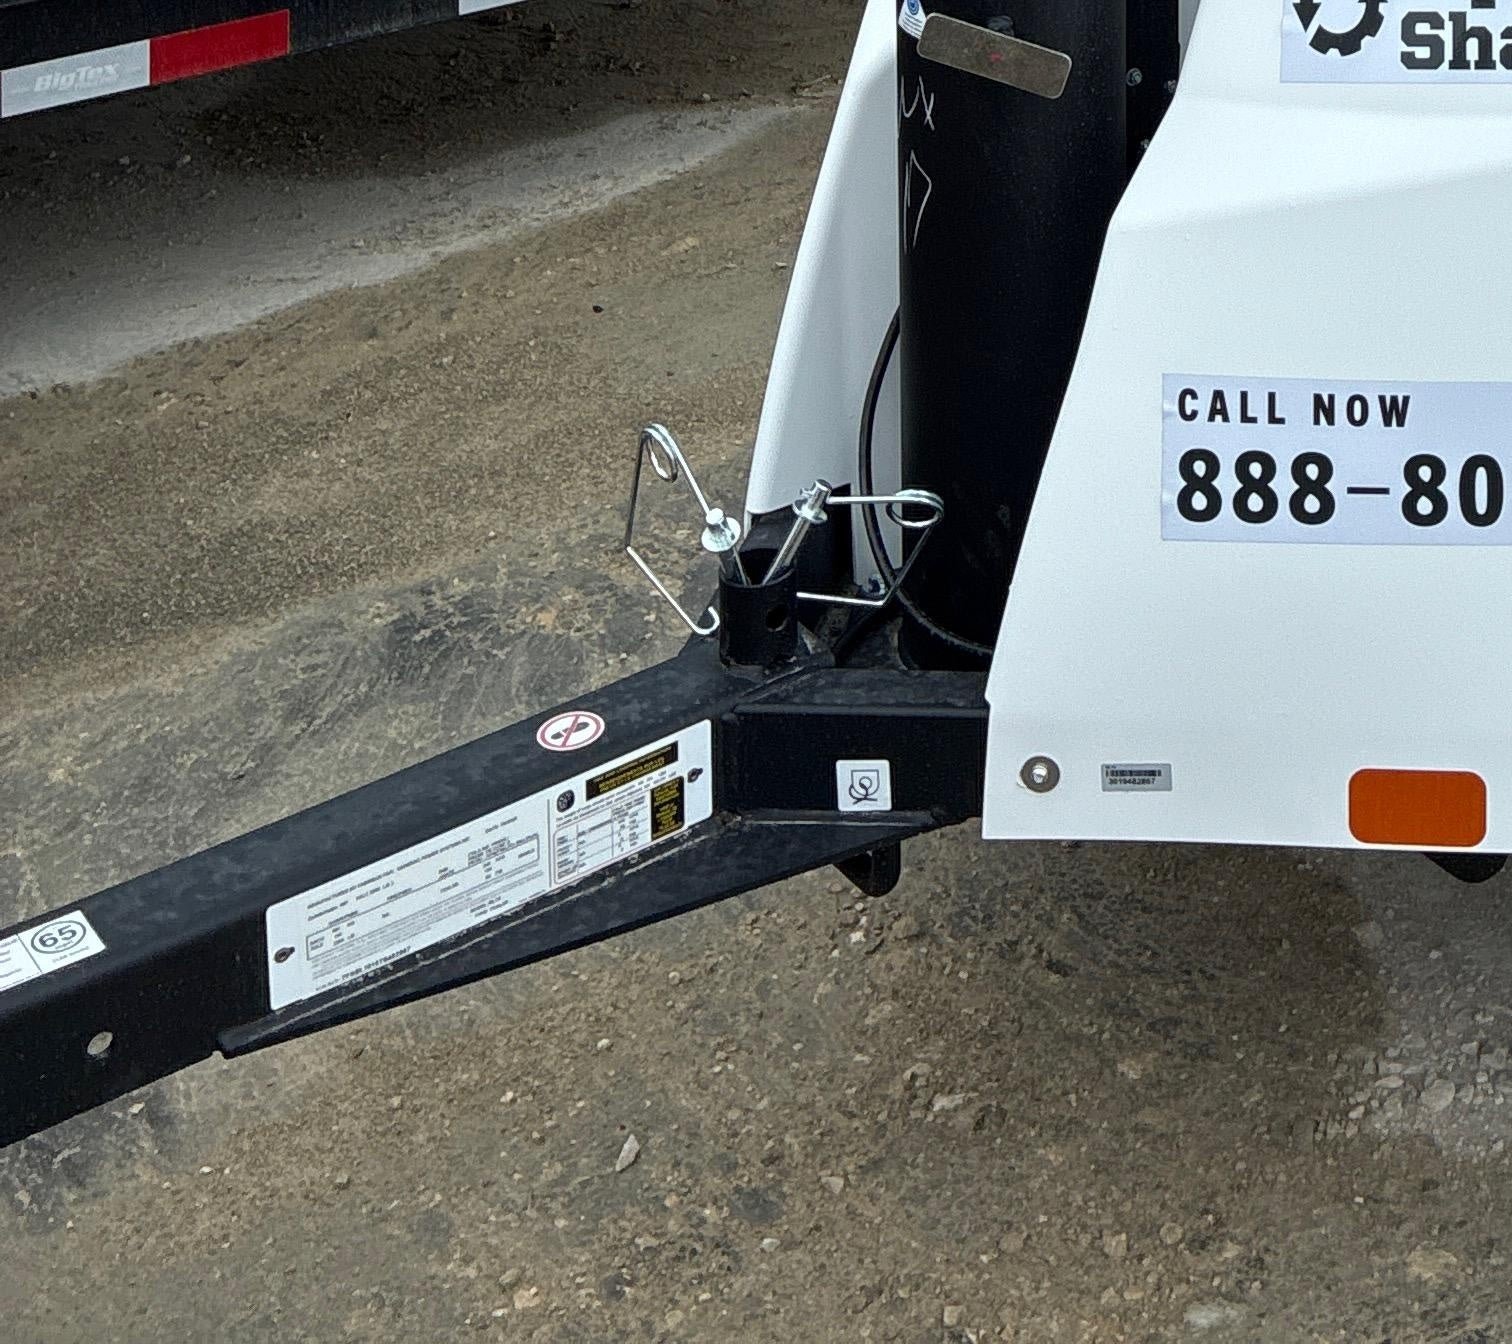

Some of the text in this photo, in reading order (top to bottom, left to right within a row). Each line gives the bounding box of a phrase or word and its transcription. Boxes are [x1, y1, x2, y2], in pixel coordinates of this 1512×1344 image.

[1177, 388, 1411, 428] CALL NOW
[38, 924, 77, 948] 65
